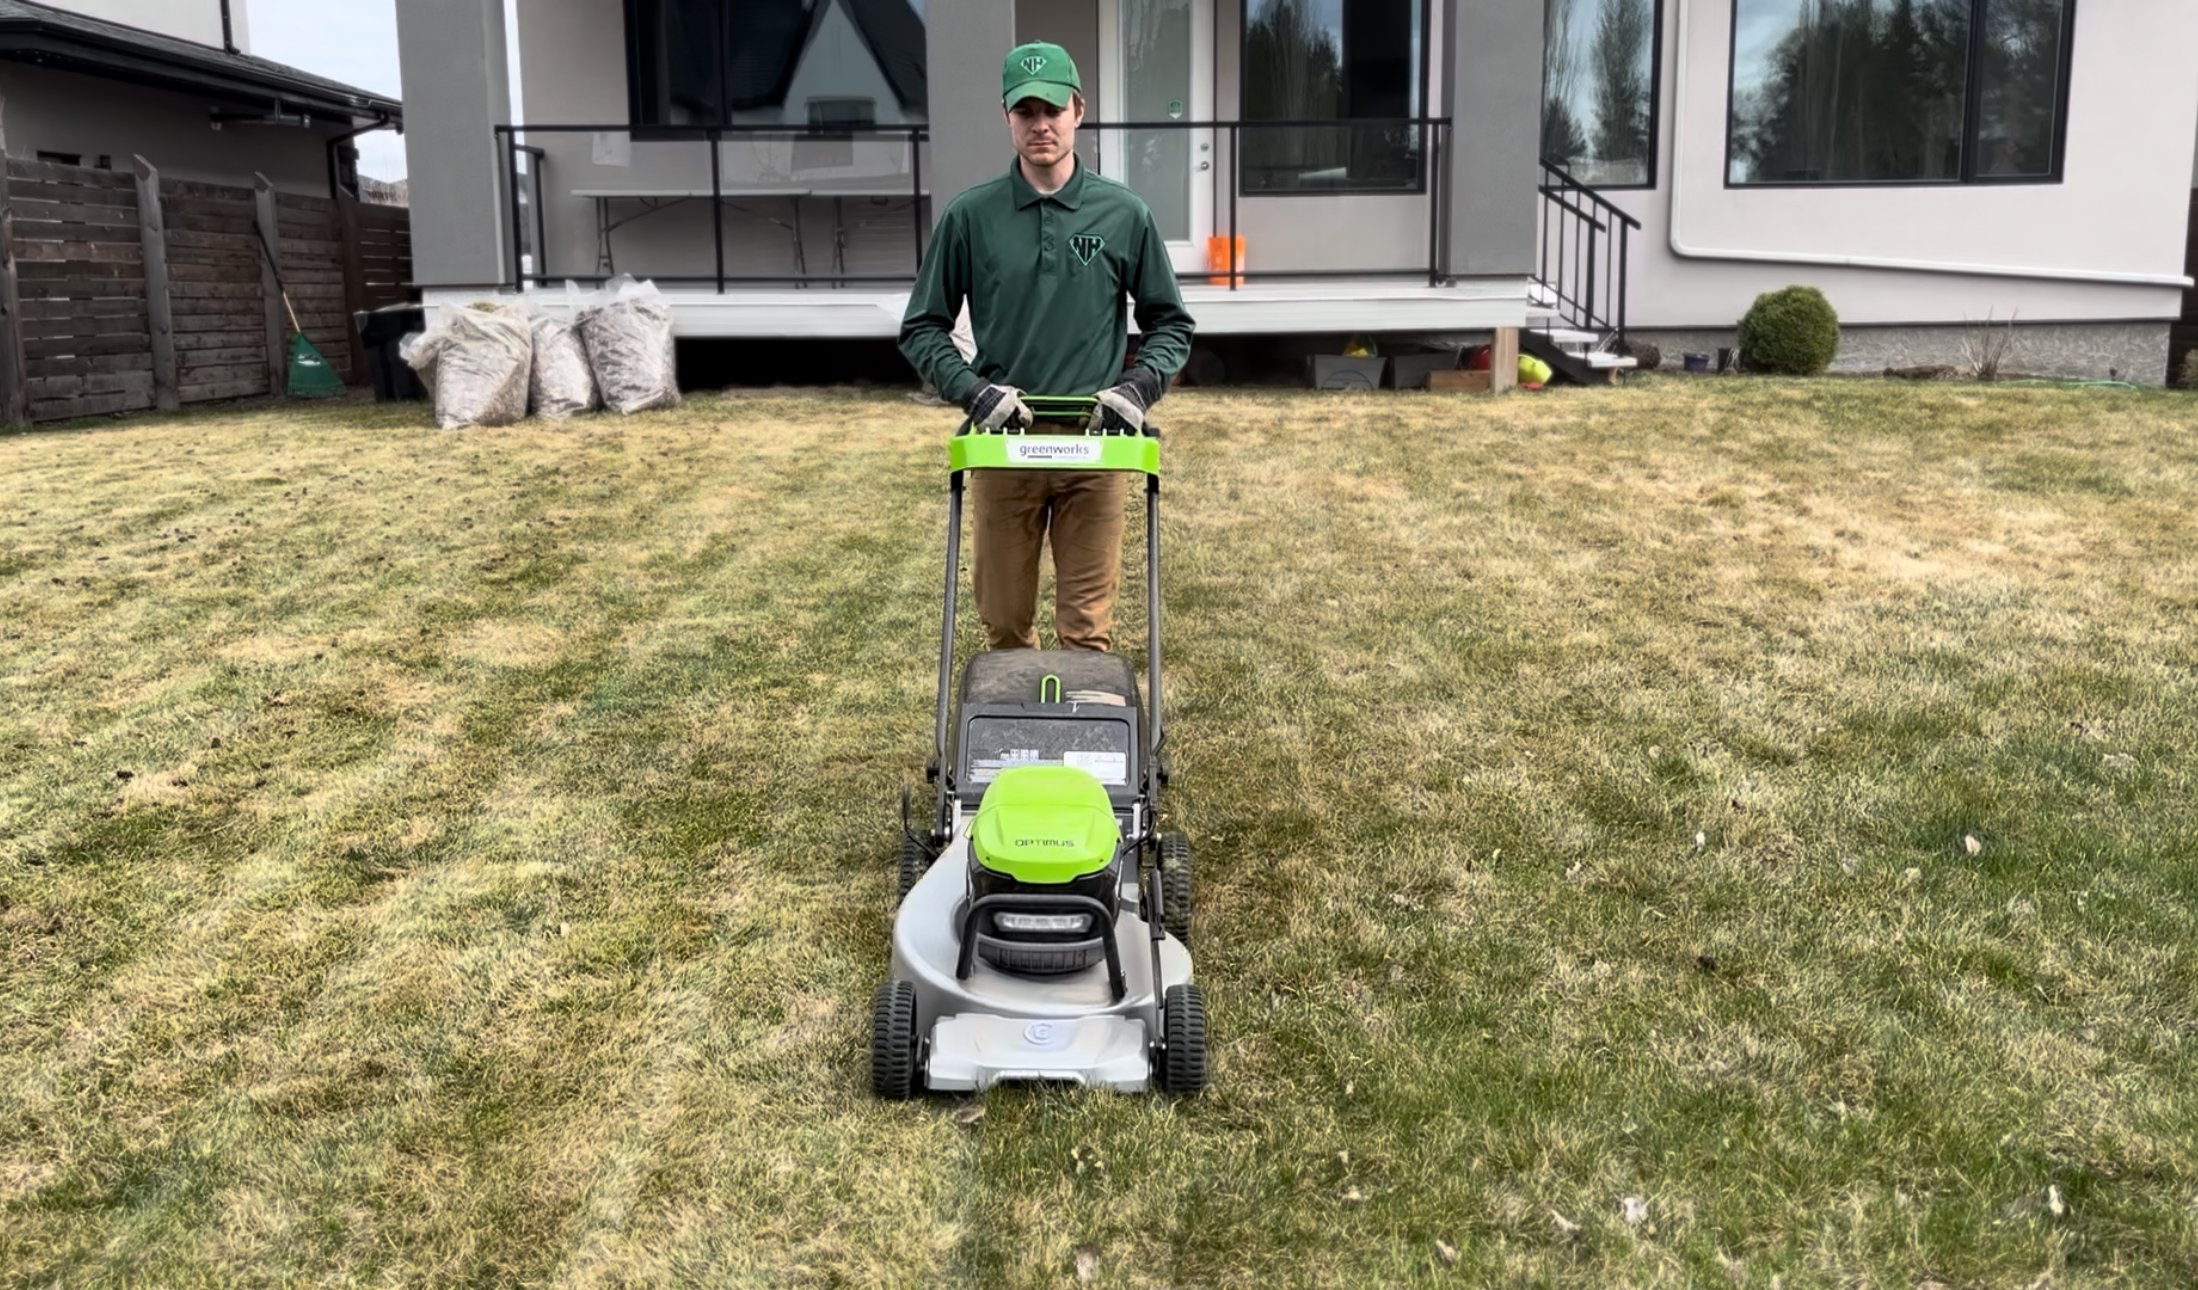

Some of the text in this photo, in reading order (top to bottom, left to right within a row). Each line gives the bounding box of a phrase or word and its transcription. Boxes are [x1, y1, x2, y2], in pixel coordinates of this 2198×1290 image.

[1023, 57, 1044, 73] NH
[1073, 236, 1101, 262] NH
[1019, 443, 1090, 457] greenworks
[1014, 838, 1075, 848] OPTIMUS
